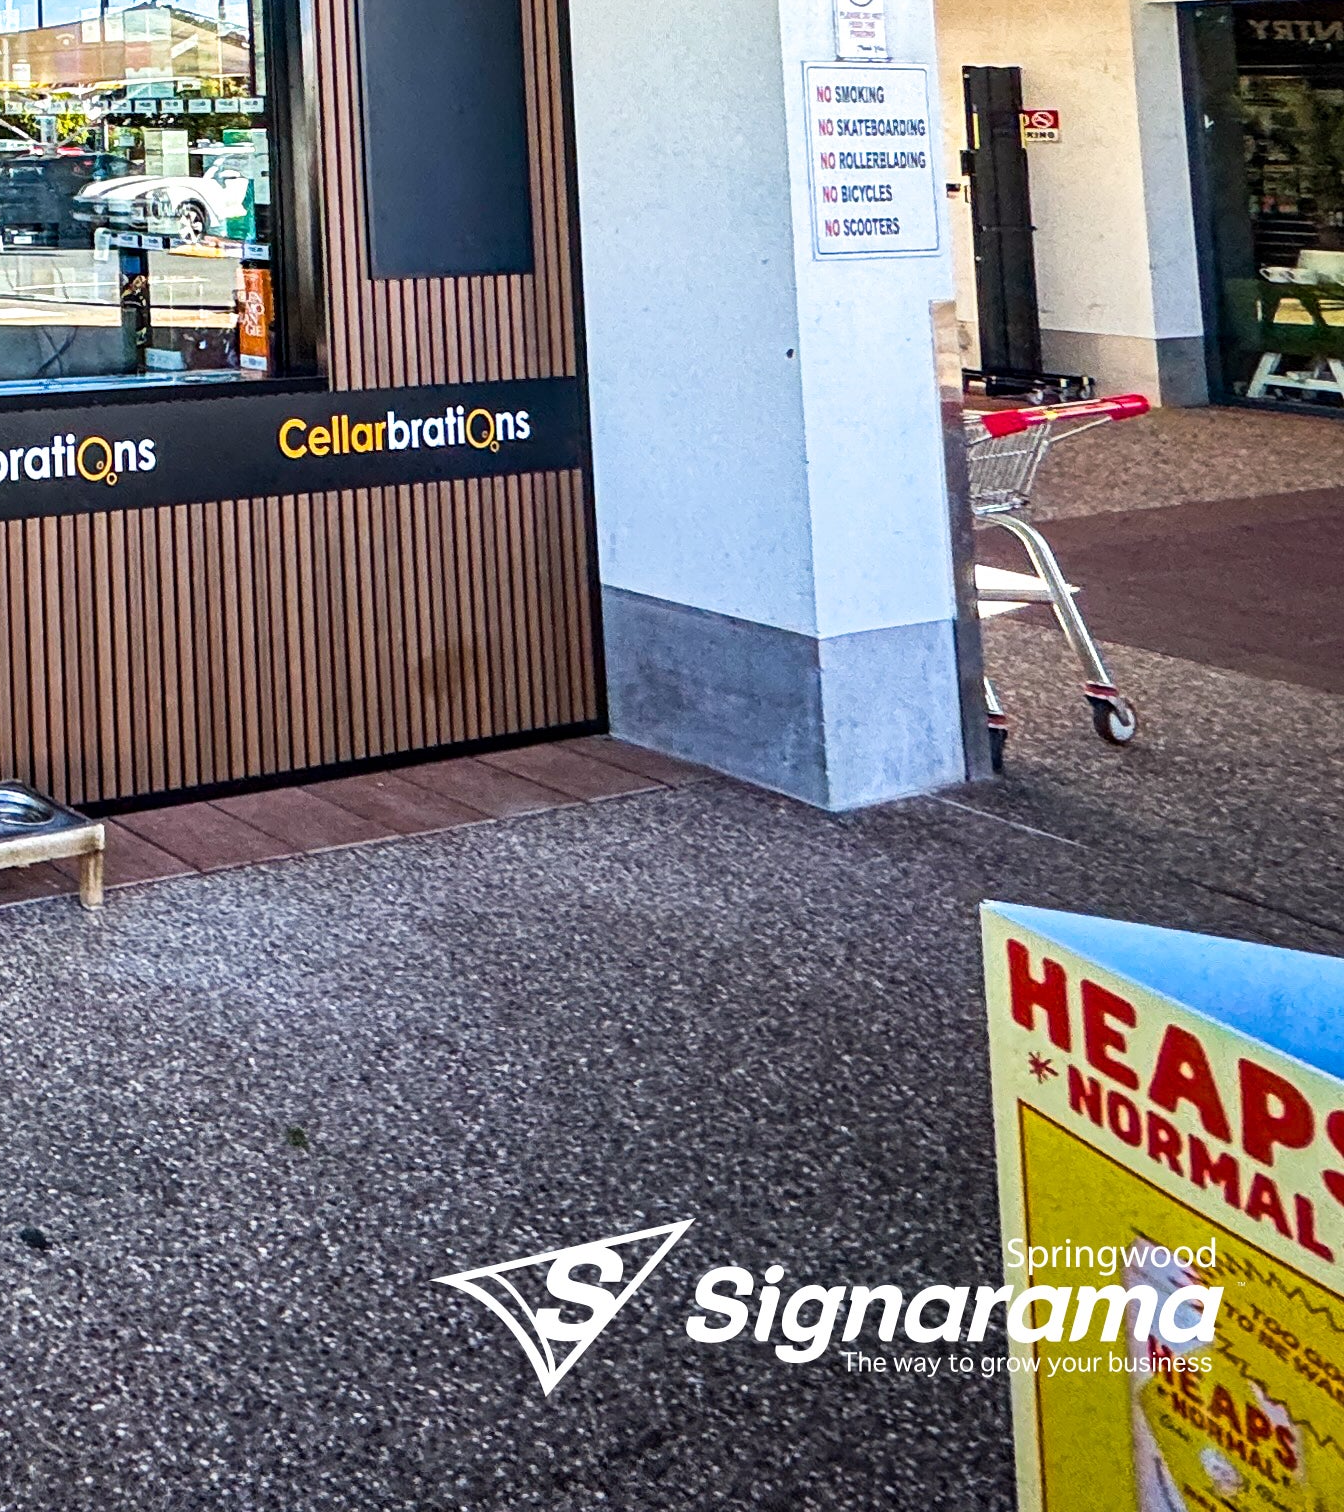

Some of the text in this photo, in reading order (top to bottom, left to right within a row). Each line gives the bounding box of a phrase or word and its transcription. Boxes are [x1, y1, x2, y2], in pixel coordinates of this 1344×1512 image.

[816, 85, 885, 104] NO SMOKING
[818, 118, 926, 137] NO SKATEBOARDING
[820, 151, 926, 170] NO ROLLERBLADING
[822, 184, 893, 203] NO BICYCLES
[825, 217, 900, 237] NO SCOOTERS
